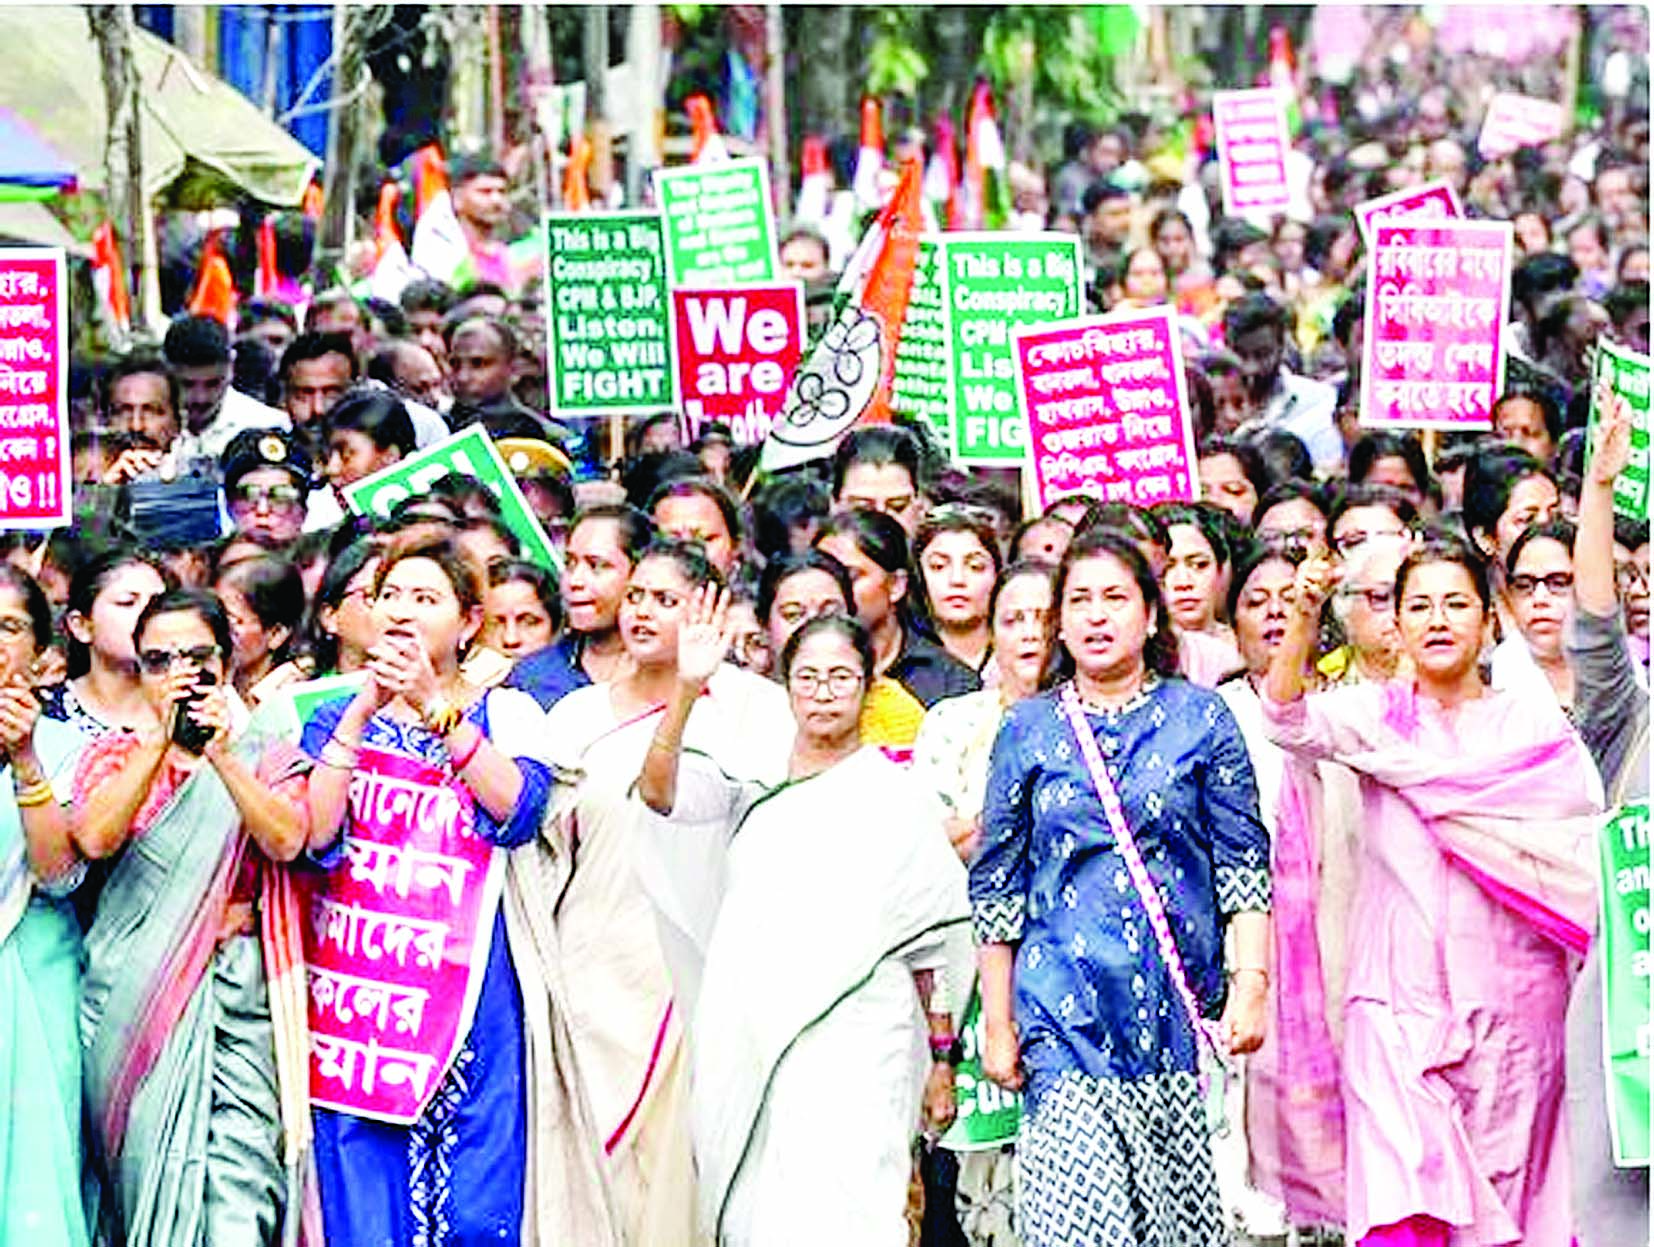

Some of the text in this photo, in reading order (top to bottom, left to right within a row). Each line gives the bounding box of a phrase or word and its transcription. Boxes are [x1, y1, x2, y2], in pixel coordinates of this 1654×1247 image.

[552, 225, 660, 255] This is a Big
[0, 270, 48, 299] হার,
[553, 254, 653, 285] Conspiracy
[952, 252, 1001, 279] This
[1003, 251, 1023, 279] is
[1026, 257, 1042, 279] a
[1045, 251, 1075, 287] Big
[557, 284, 598, 310] CPM
[601, 284, 618, 310] &
[953, 284, 1065, 318] Conspiracy
[684, 297, 789, 356] We
[960, 319, 1007, 346] CPM
[560, 342, 666, 369] We Will
[960, 351, 1014, 379] Lis
[563, 369, 665, 401] FIGHT
[695, 360, 785, 397] are
[962, 383, 1014, 412] We
[965, 414, 1024, 449] FIG
[1618, 814, 1650, 852] Th
[345, 837, 476, 906] ম্মান
[1615, 866, 1650, 894] an
[1632, 907, 1650, 934] o
[306, 963, 432, 1038] কলের
[307, 1030, 438, 1104] ম্মান
